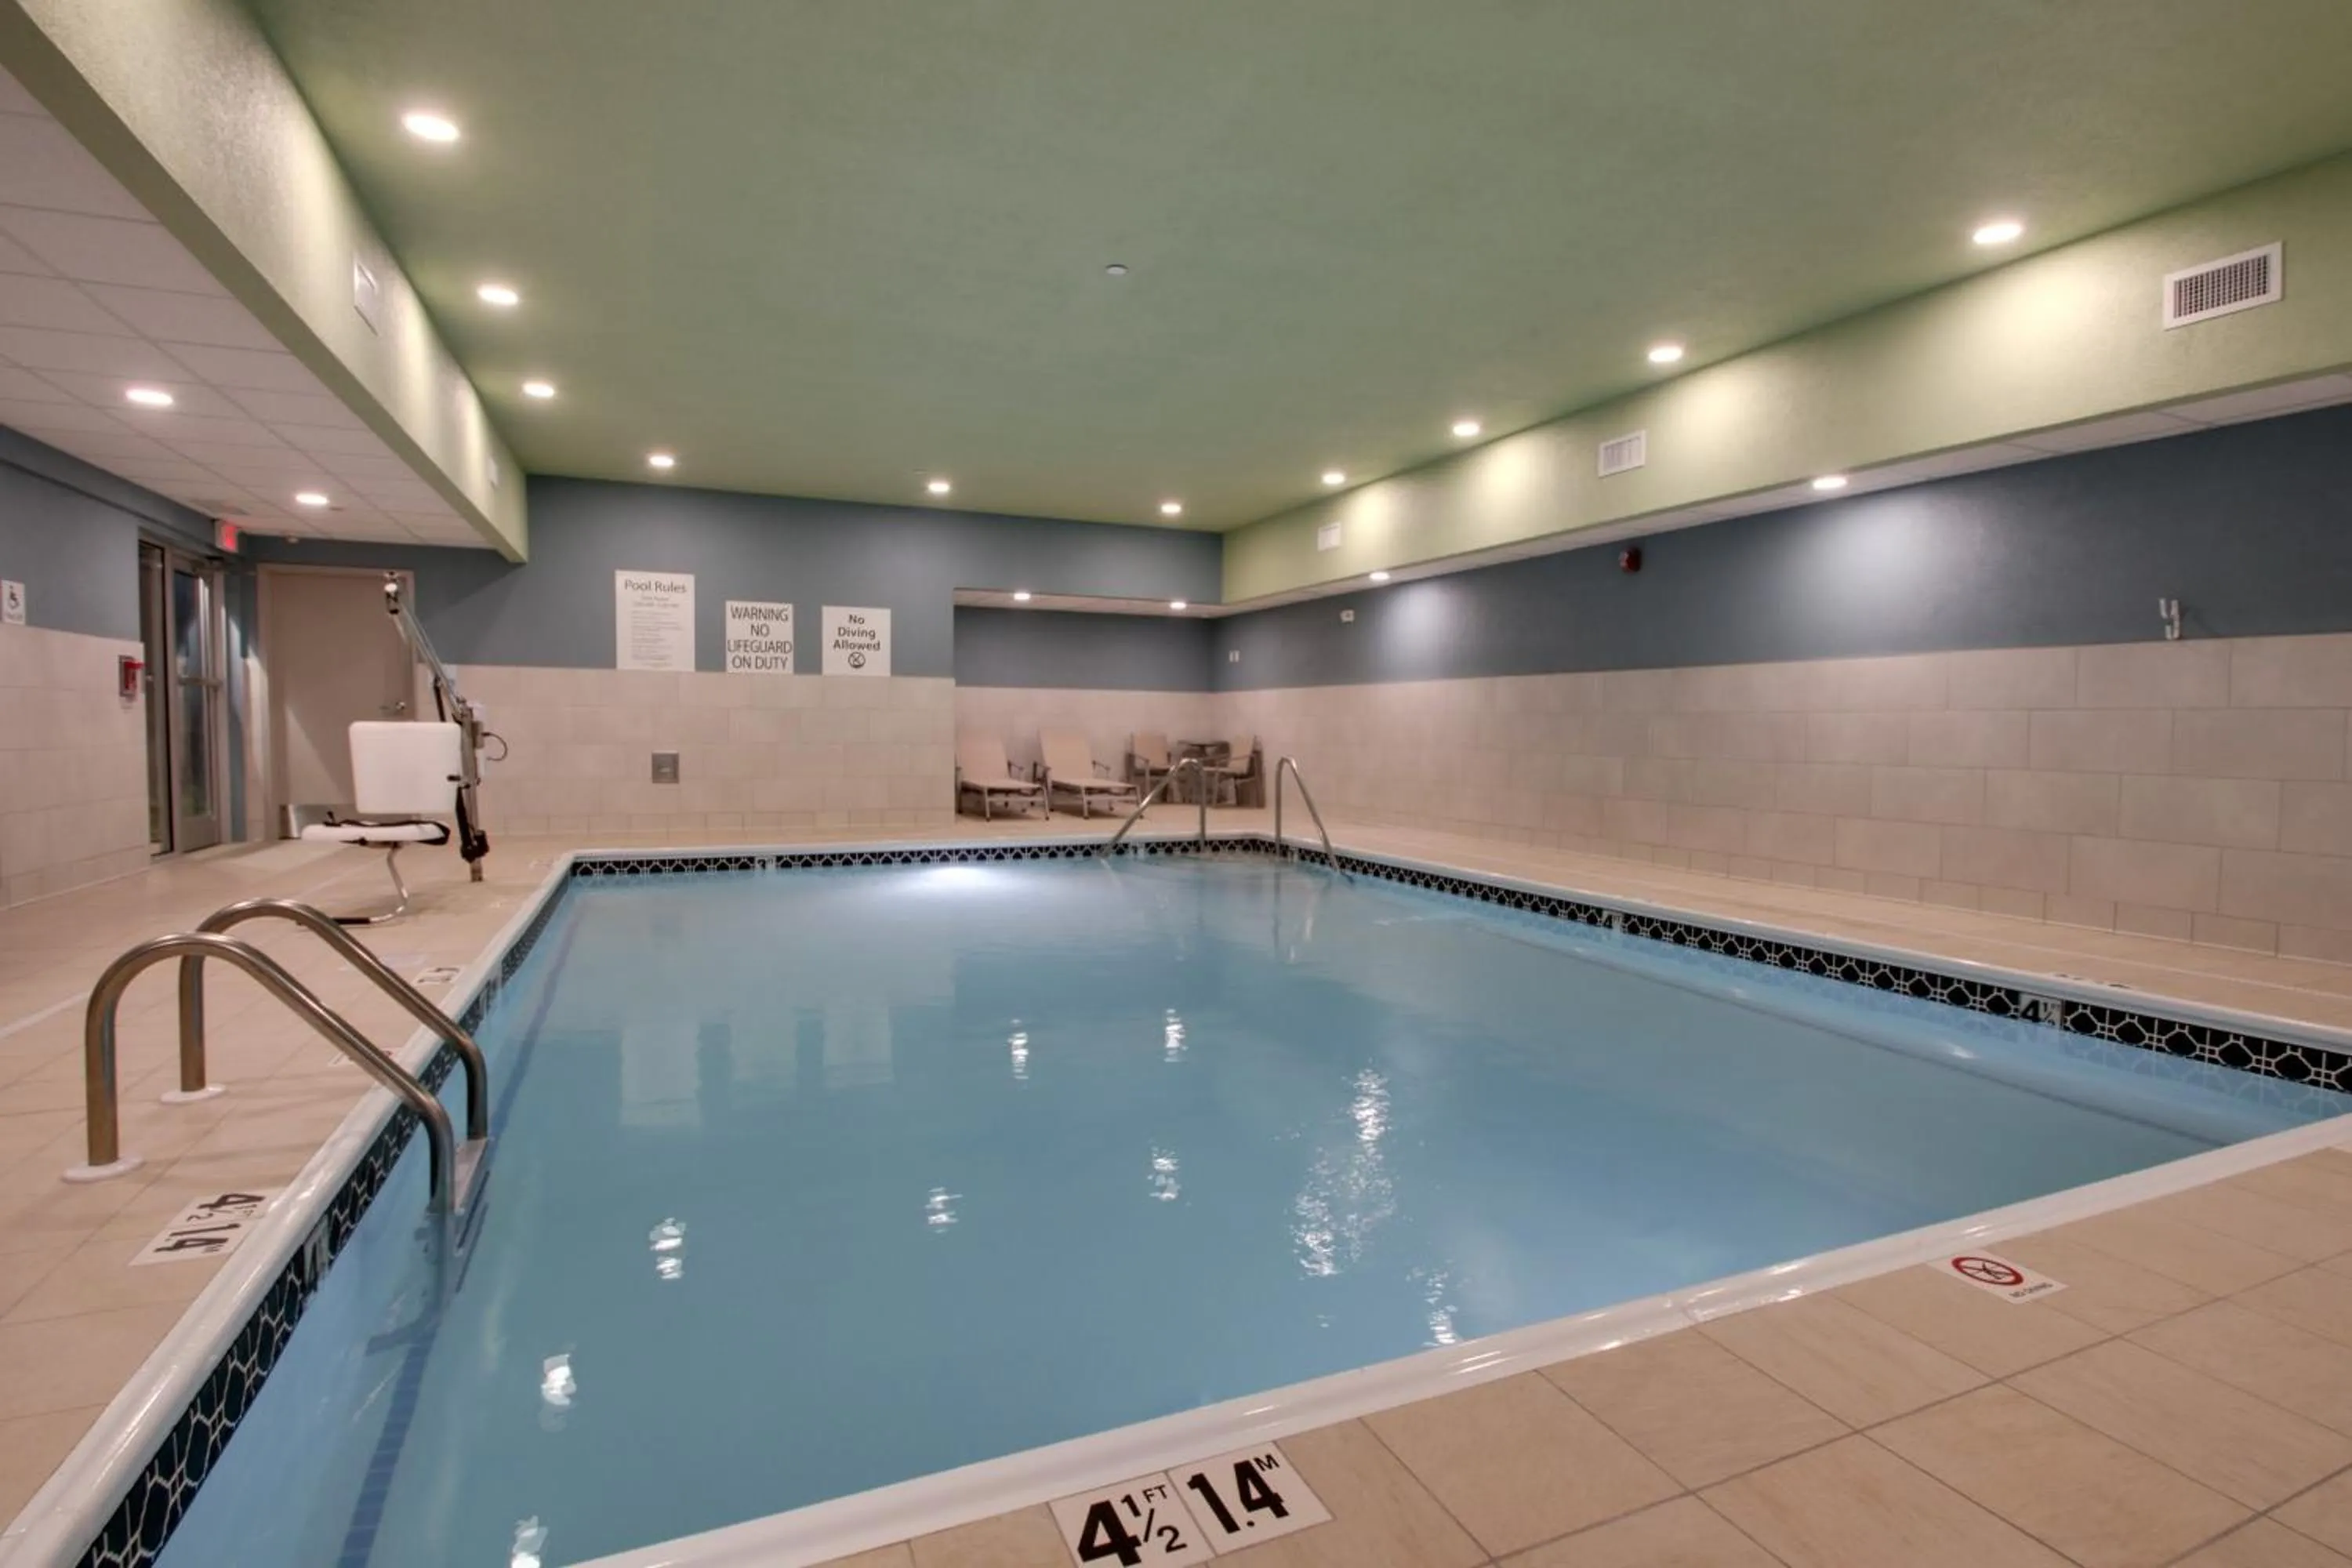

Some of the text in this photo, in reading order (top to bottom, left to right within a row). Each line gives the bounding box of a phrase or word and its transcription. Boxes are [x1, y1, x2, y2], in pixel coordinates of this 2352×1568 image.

[625, 579, 687, 593] Pool Rules
[730, 604, 789, 622] WARNING
[849, 614, 865, 625] No
[750, 623, 770, 637] NO
[838, 626, 876, 641] Diving
[727, 639, 793, 654] LIFEGUARD
[833, 639, 880, 652] Allowed
[731, 655, 788, 670] ON DUTY
[1142, 1484, 1168, 1504] FT
[1185, 1453, 1290, 1534] 1.4 M
